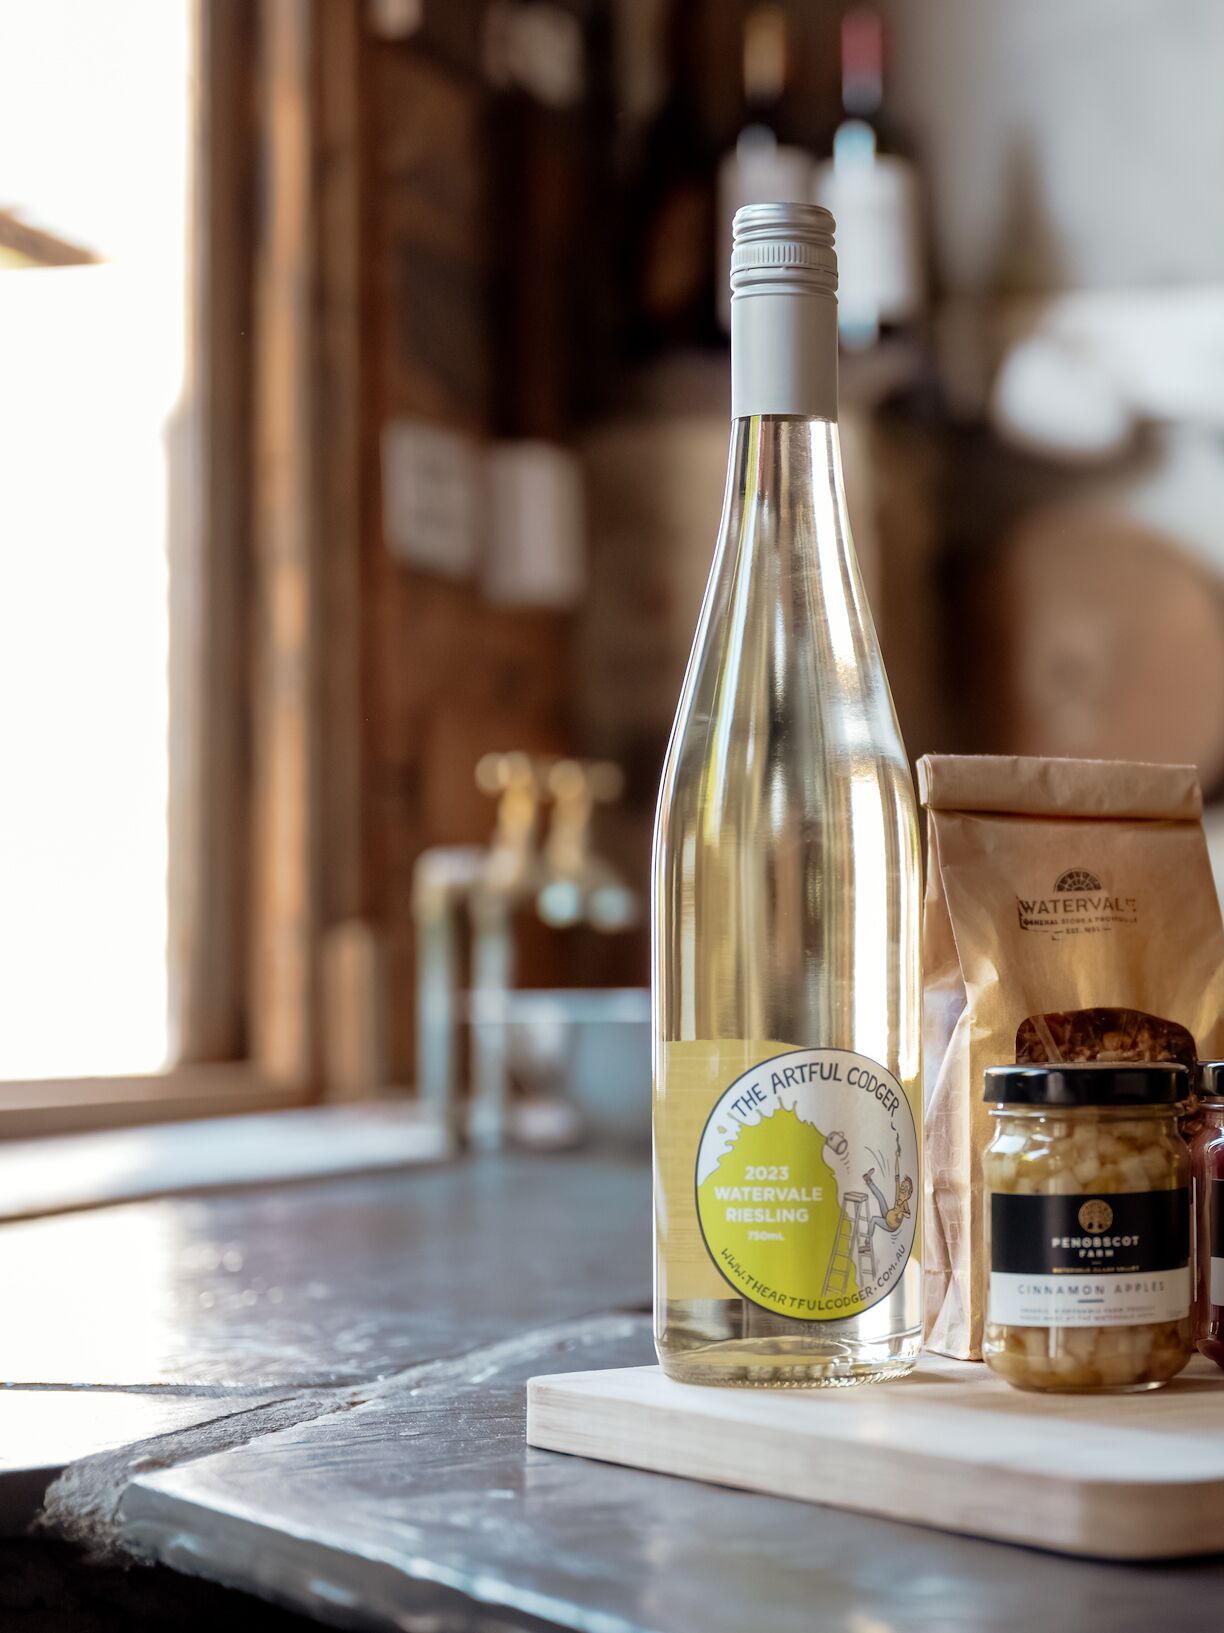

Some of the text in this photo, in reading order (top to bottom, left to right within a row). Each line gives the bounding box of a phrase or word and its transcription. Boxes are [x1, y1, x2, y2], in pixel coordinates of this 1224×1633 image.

[731, 1062, 900, 1118] THE ARTFUL CODGER
[744, 1165, 789, 1181] 2023
[714, 1186, 823, 1202] WATERVALE
[726, 1207, 810, 1223] RIESLING
[1051, 1235, 1140, 1249] PENOBSCOT
[1078, 1249, 1114, 1259] FARM
[721, 1244, 906, 1312] WWW.THEARTFULCODGER.COM.AU
[1017, 1280, 1166, 1296] CINNAMON APPLES
